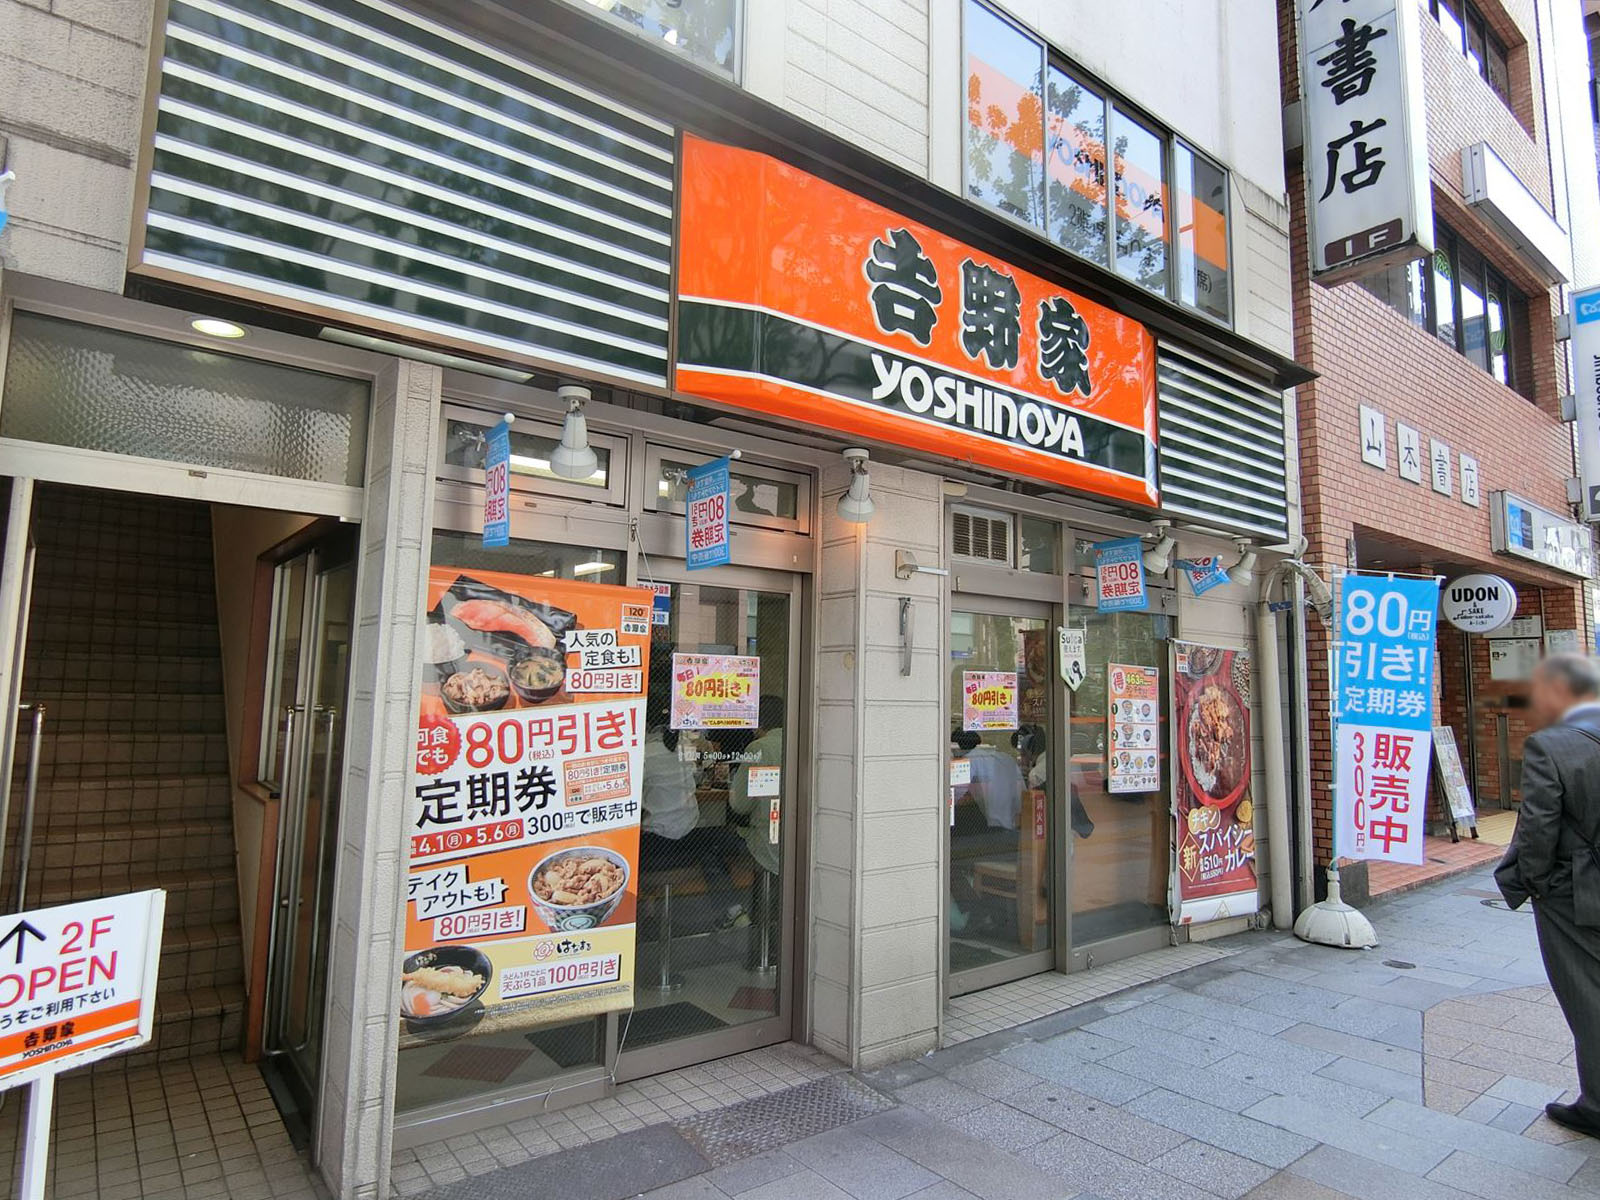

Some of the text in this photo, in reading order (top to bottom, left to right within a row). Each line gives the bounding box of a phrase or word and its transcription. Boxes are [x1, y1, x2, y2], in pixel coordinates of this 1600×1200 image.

[1309, 0, 1387, 203] 書店
[865, 227, 1092, 398] 吉野家
[871, 353, 1085, 458] YOSHINOYA
[1365, 417, 1476, 500] 山本書店
[1451, 586, 1499, 603] UDON
[629, 607, 644, 617] 120
[1467, 607, 1484, 615] SAKE
[569, 631, 614, 649] 人気の
[584, 648, 636, 666] 定食も!
[1344, 686, 1427, 718] 定期券
[415, 765, 557, 828] 定期券
[1369, 733, 1414, 854] 販売中
[527, 800, 638, 836] 300円で販売中
[1192, 808, 1218, 827] チキン
[1183, 844, 1197, 871] 新
[408, 871, 458, 896] テイク
[422, 883, 496, 913] アウトも!
[59, 914, 115, 955] 2F
[0, 950, 118, 1009] OPEN
[547, 958, 618, 985] 100円引き
